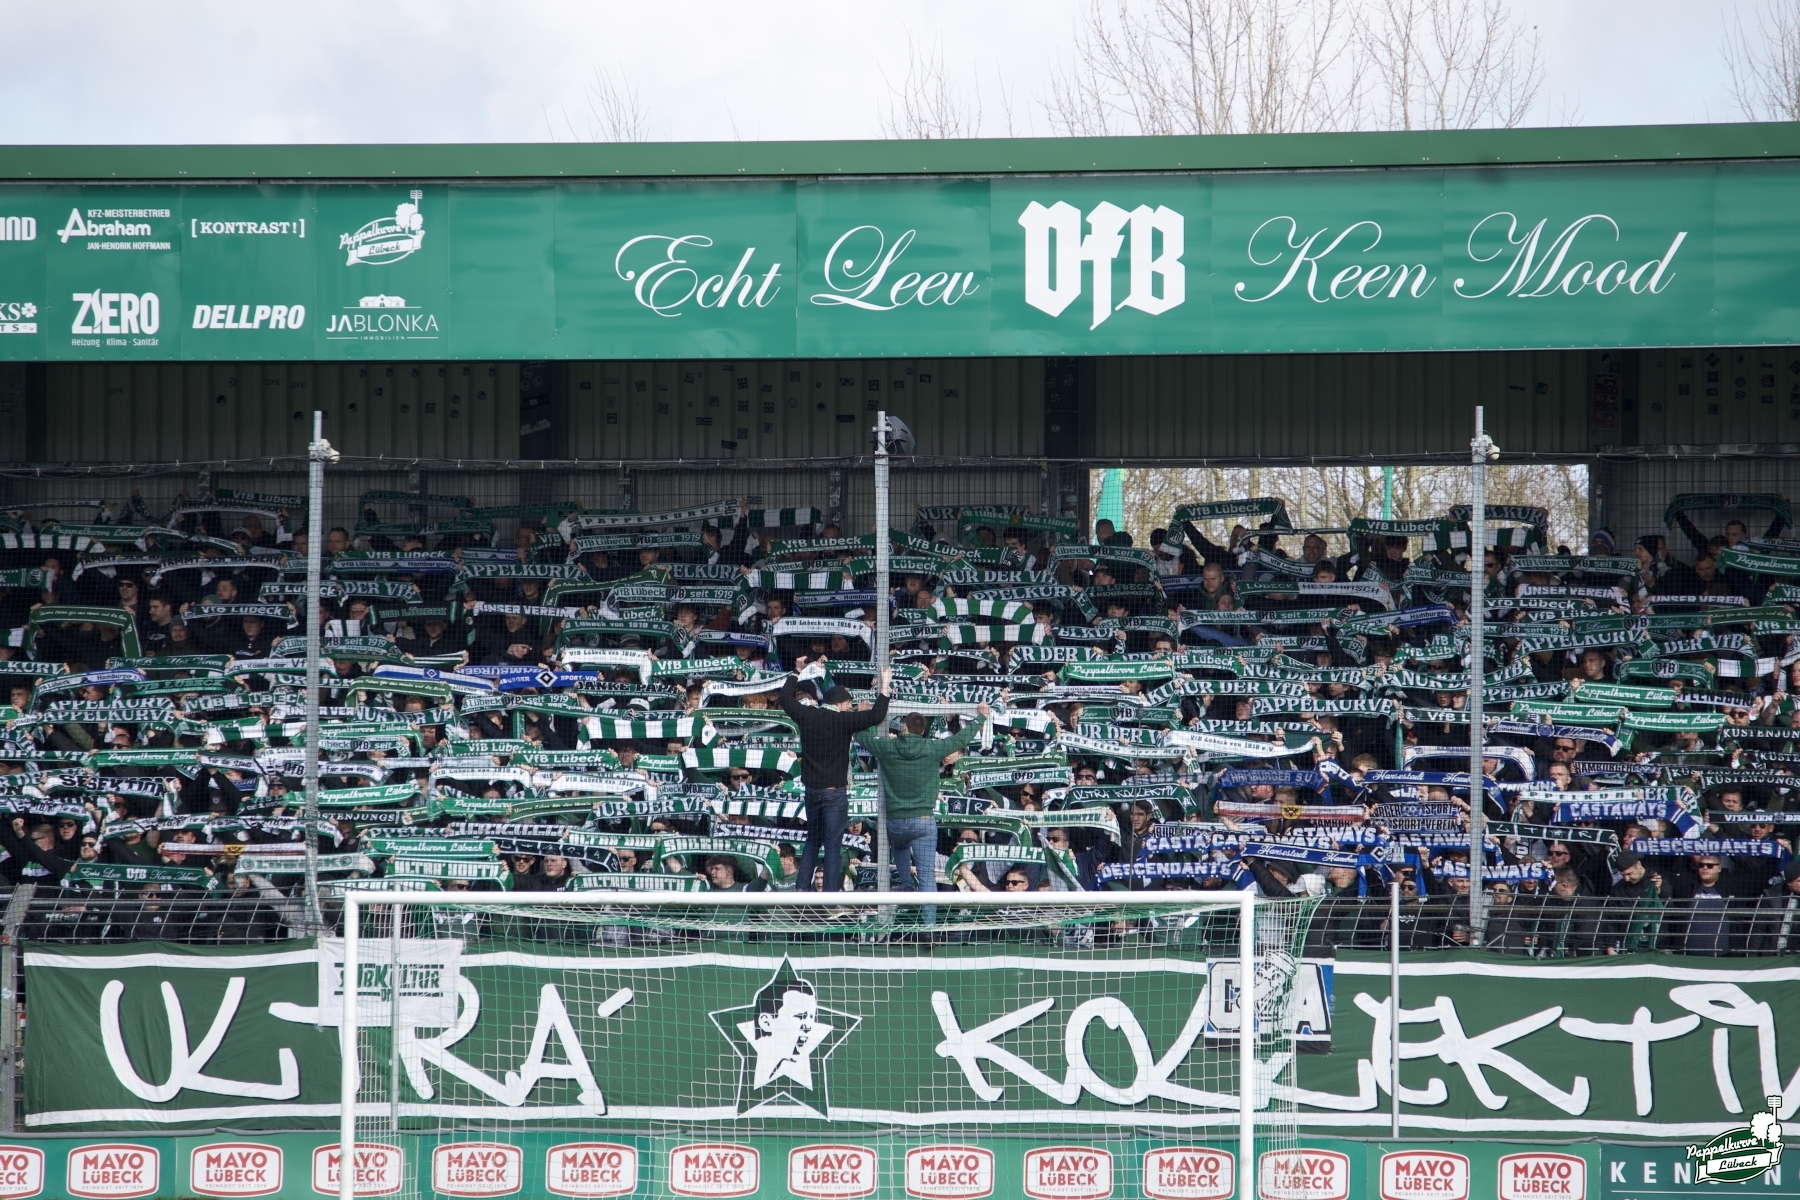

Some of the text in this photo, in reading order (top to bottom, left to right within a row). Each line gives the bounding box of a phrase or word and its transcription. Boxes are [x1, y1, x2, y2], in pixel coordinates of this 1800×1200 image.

[88, 209, 170, 218] KFZ-MEISTERBETRIEB
[0, 216, 36, 240] ND
[57, 208, 151, 243] Abraham
[339, 222, 402, 250] Pappelkurve
[87, 242, 171, 250] JAN-HENDRIK HOFFMANN
[368, 241, 400, 256] Lübeck
[615, 200, 1688, 331] Echt Leev VfB Keen Mood
[192, 305, 305, 329] DELLPRO
[326, 314, 439, 332] JABLONKA
[72, 338, 159, 347] Heizung Klima Sanitär
[233, 491, 301, 505] VfB Lübeck
[585, 506, 721, 525] PAPPELKURVE
[1187, 503, 1260, 517] VfB Lübeck
[1366, 520, 1440, 532] VfB Lübeck
[595, 536, 630, 546] Lübeck
[656, 534, 675, 542] seit
[680, 533, 701, 541] 1919
[782, 536, 861, 549] VfB Lübeck
[908, 536, 981, 559] VfB Lübeck
[1594, 559, 1612, 568] seit
[1617, 560, 1637, 571] 1919
[1736, 554, 1798, 571] Pappelkurve
[631, 588, 665, 596] Lübeck
[690, 590, 709, 598] seit
[714, 590, 733, 598] 1919
[402, 607, 447, 617] LÜBECK
[1217, 611, 1255, 619] Lübeck
[657, 656, 736, 670] VfB Lübeck
[1173, 655, 1235, 666] VfB Lübeck
[1073, 663, 1172, 675] Pappelkurve Lübeck
[1243, 667, 1361, 684] NUR DER VfB
[1220, 681, 1304, 697] DER VfB
[1578, 685, 1640, 700] Pappelkurve
[1252, 699, 1393, 714] PAPPELKURVE
[1626, 713, 1688, 725] Pappelkurve
[524, 754, 603, 763] VfB Lübeck
[1230, 771, 1291, 782] HAMBURGER
[318, 789, 381, 800] Pappelkurve
[1570, 804, 1667, 817] CASTAWAYS
[1724, 814, 1773, 822] VITALIEN
[385, 841, 483, 852] Pappelkurve Lübeck
[1258, 846, 1308, 859] Hansestadt
[1638, 840, 1773, 854] DESCENDANTS
[126, 868, 147, 879] VfB
[1101, 861, 1232, 877] DESCENDANTS
[339, 965, 440, 988] SBKLTUR
[0, 1154, 28, 1170] YO
[83, 1153, 144, 1169] MAYO
[206, 1152, 267, 1168] MAYO
[448, 1152, 507, 1168] MAYO
[562, 1152, 622, 1168] MAYO
[685, 1153, 744, 1169] MAYO
[804, 1154, 862, 1170] MAYO
[921, 1154, 979, 1170] MAYO
[1040, 1155, 1098, 1171] MAYO
[1159, 1156, 1219, 1172] MAYO
[1274, 1158, 1335, 1174] MAYO
[1395, 1159, 1455, 1175] MAYO
[83, 1170, 142, 1183] LÜBECK
[206, 1169, 265, 1182] LÜBECK
[448, 1169, 505, 1182] LÜBECK
[562, 1169, 620, 1182] LÜBECK
[685, 1170, 742, 1183] LÜBECK
[1514, 1162, 1571, 1178] MAYO
[1610, 1161, 1800, 1186] KENN
[804, 1171, 860, 1184] LÜBECK
[921, 1171, 977, 1184] LÜBECK
[1040, 1172, 1096, 1185] LÜBECK
[1159, 1173, 1217, 1186] LÜBECK
[1274, 1175, 1333, 1188] LÜBECK
[1395, 1176, 1453, 1189] LÜBECK
[1514, 1179, 1569, 1192] LÜBECK
